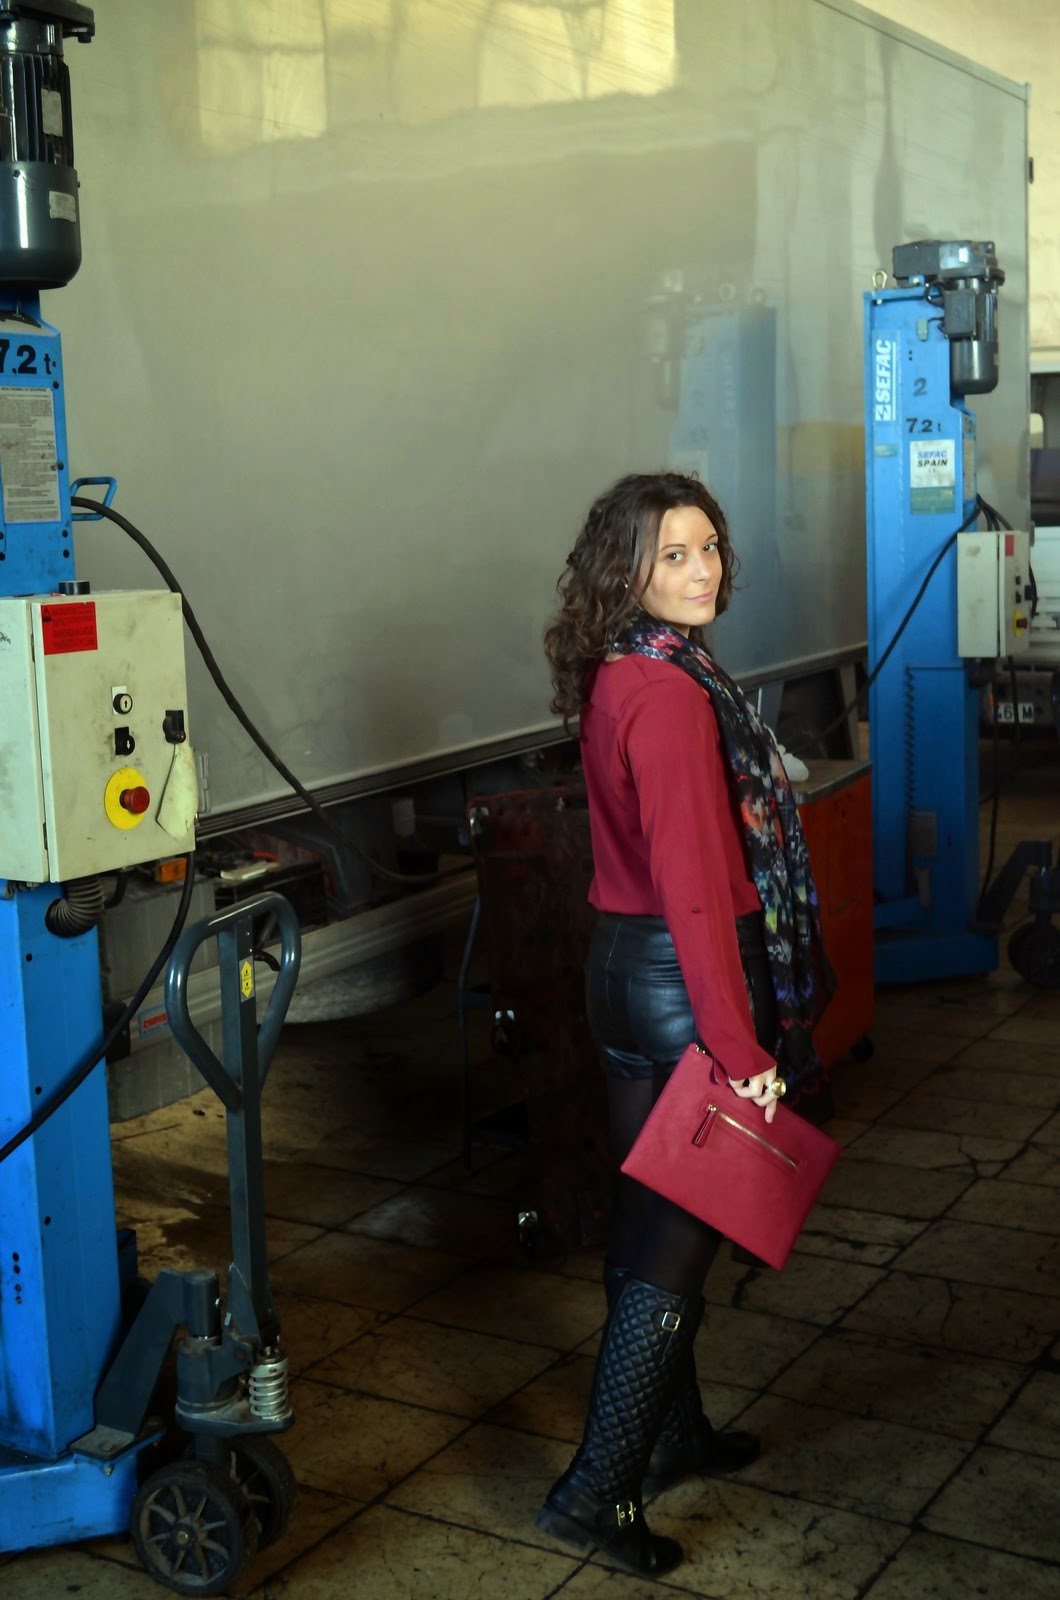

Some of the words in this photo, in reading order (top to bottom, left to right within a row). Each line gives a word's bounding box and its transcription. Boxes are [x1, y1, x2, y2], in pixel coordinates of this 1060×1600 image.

[875, 339, 891, 403] SEFAC
[913, 377, 927, 397] 2
[917, 450, 947, 459] SEFAC
[917, 459, 948, 468] SPAIN
